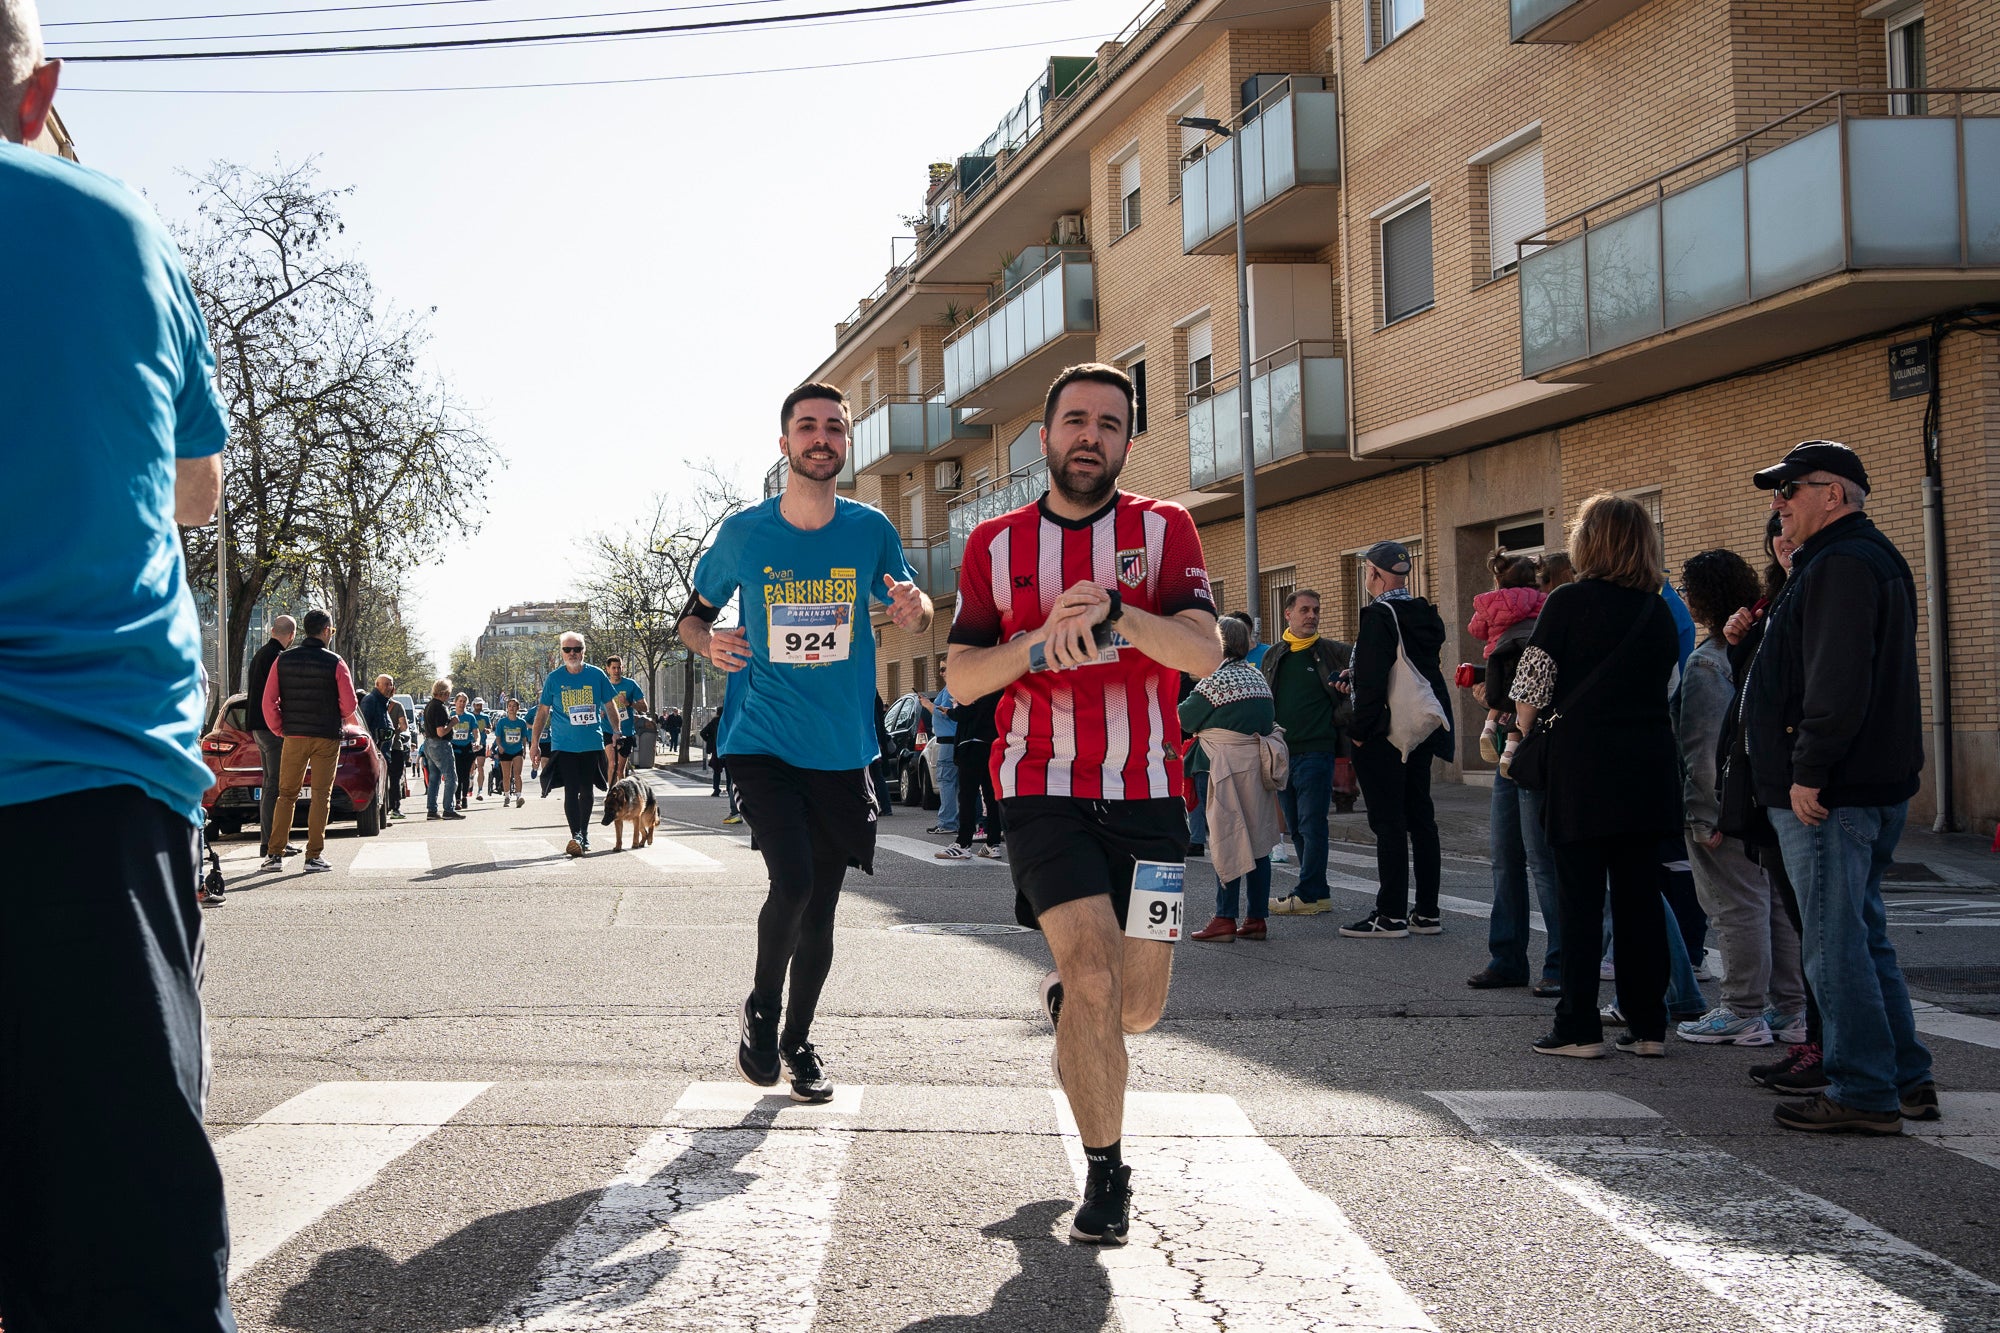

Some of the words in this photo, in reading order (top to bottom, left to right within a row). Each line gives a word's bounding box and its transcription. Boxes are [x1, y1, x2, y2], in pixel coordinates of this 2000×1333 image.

[1900, 347, 1917, 357] CARRER
[1893, 364, 1926, 379] VOLUNTARIS
[769, 570, 793, 579] avan
[764, 580, 856, 599] PARKINSON
[785, 631, 837, 651] 924
[572, 713, 594, 722] 1165
